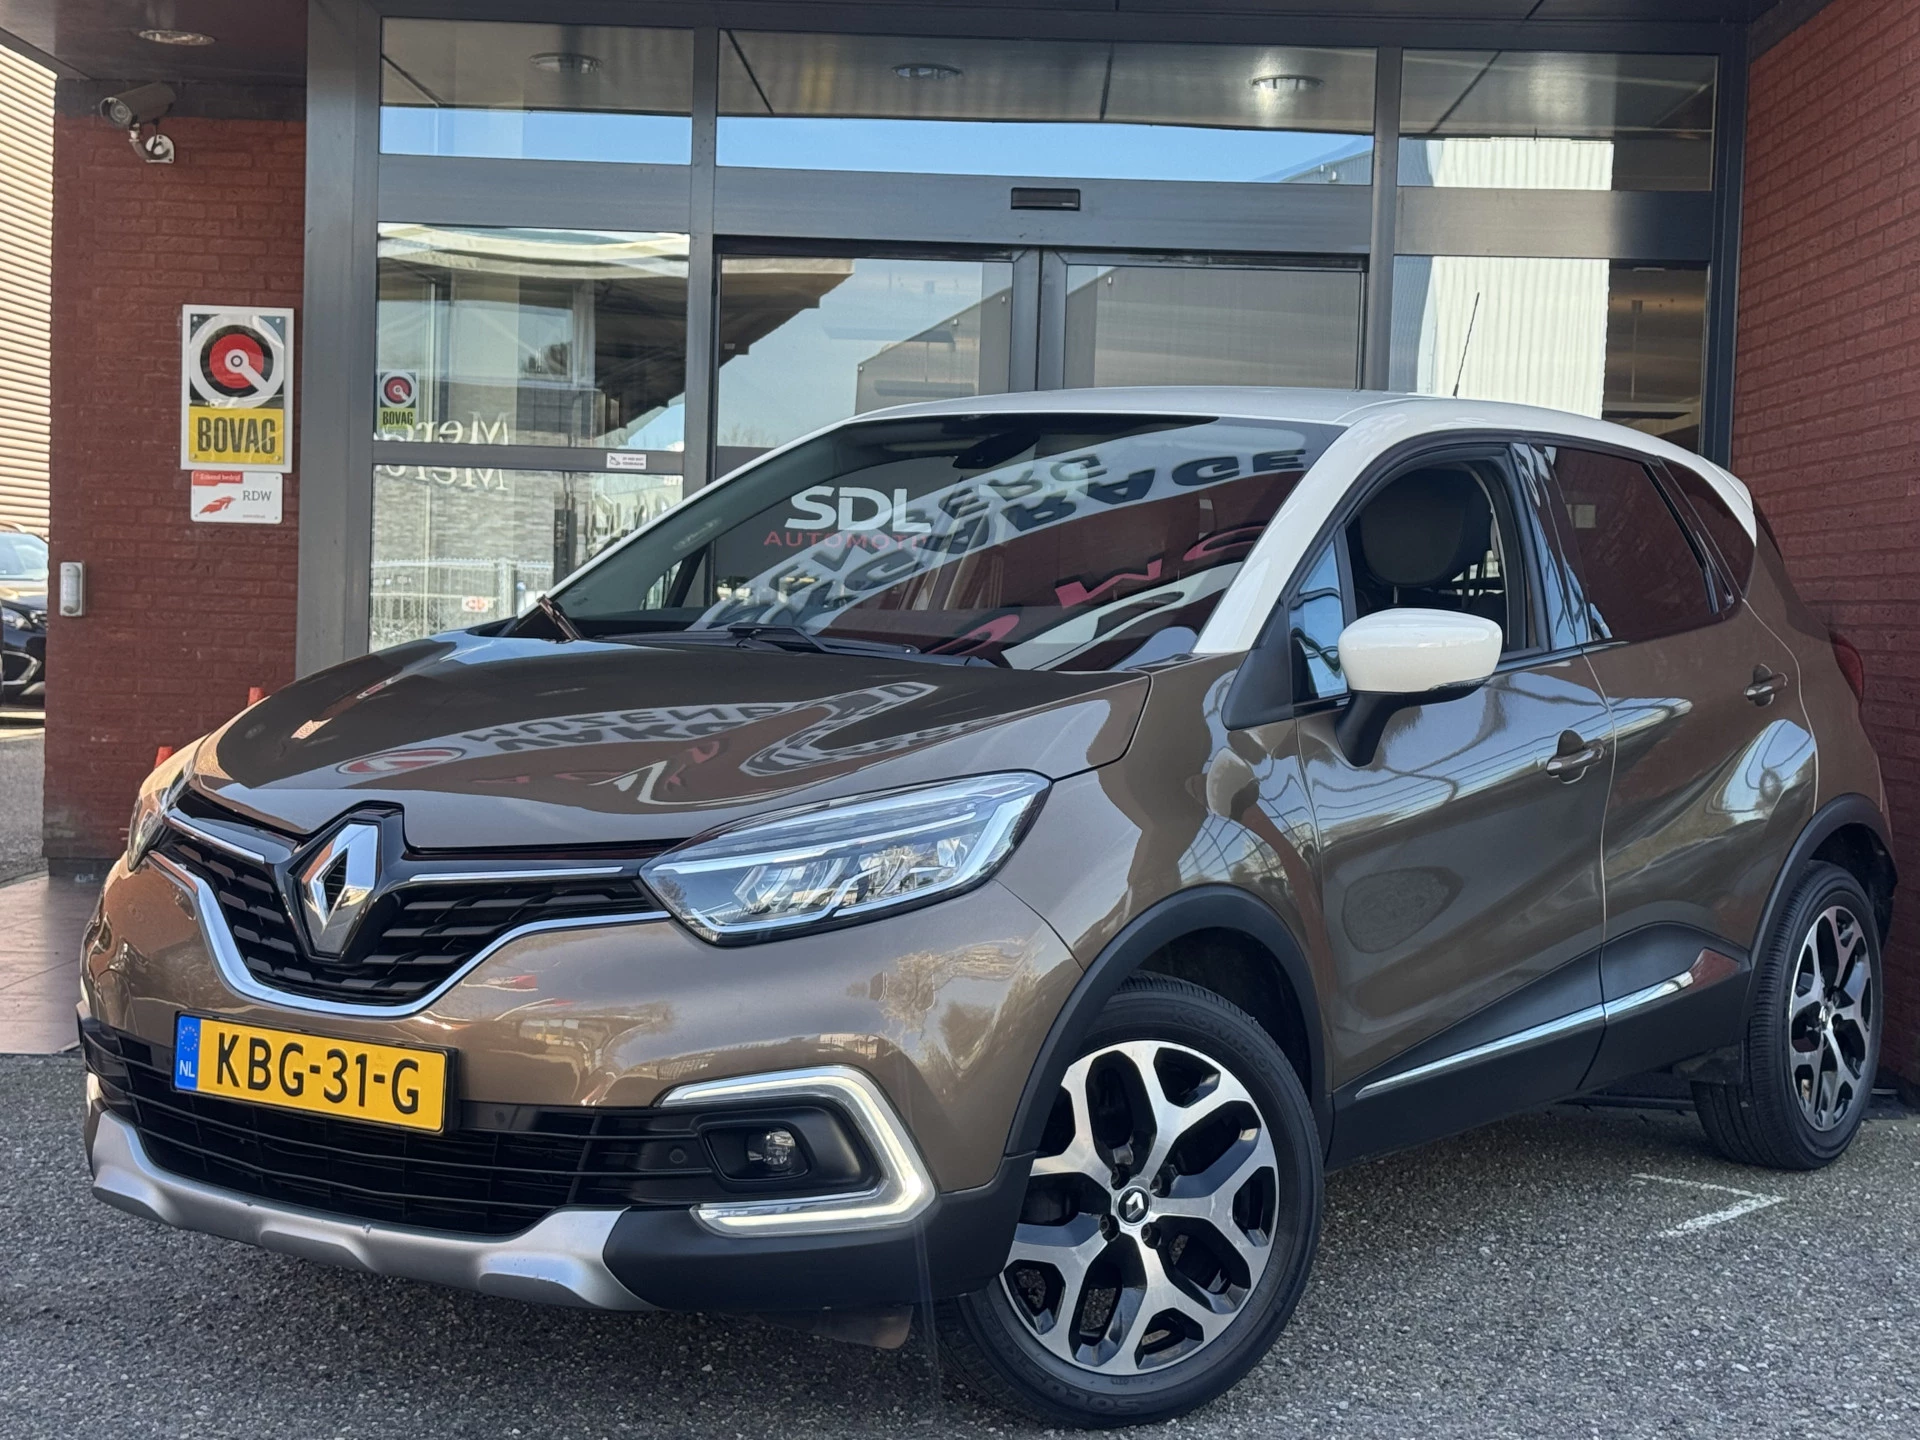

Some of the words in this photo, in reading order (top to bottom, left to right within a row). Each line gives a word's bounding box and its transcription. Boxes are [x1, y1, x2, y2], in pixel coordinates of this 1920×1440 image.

[383, 411, 413, 425] BOVAG
[197, 416, 276, 454] BOVAG
[242, 490, 272, 501] RDW
[784, 485, 932, 533] SDL
[764, 531, 927, 550] AUTOMOTI
[179, 1059, 195, 1078] NL
[216, 1033, 419, 1114] KBG-31-G
